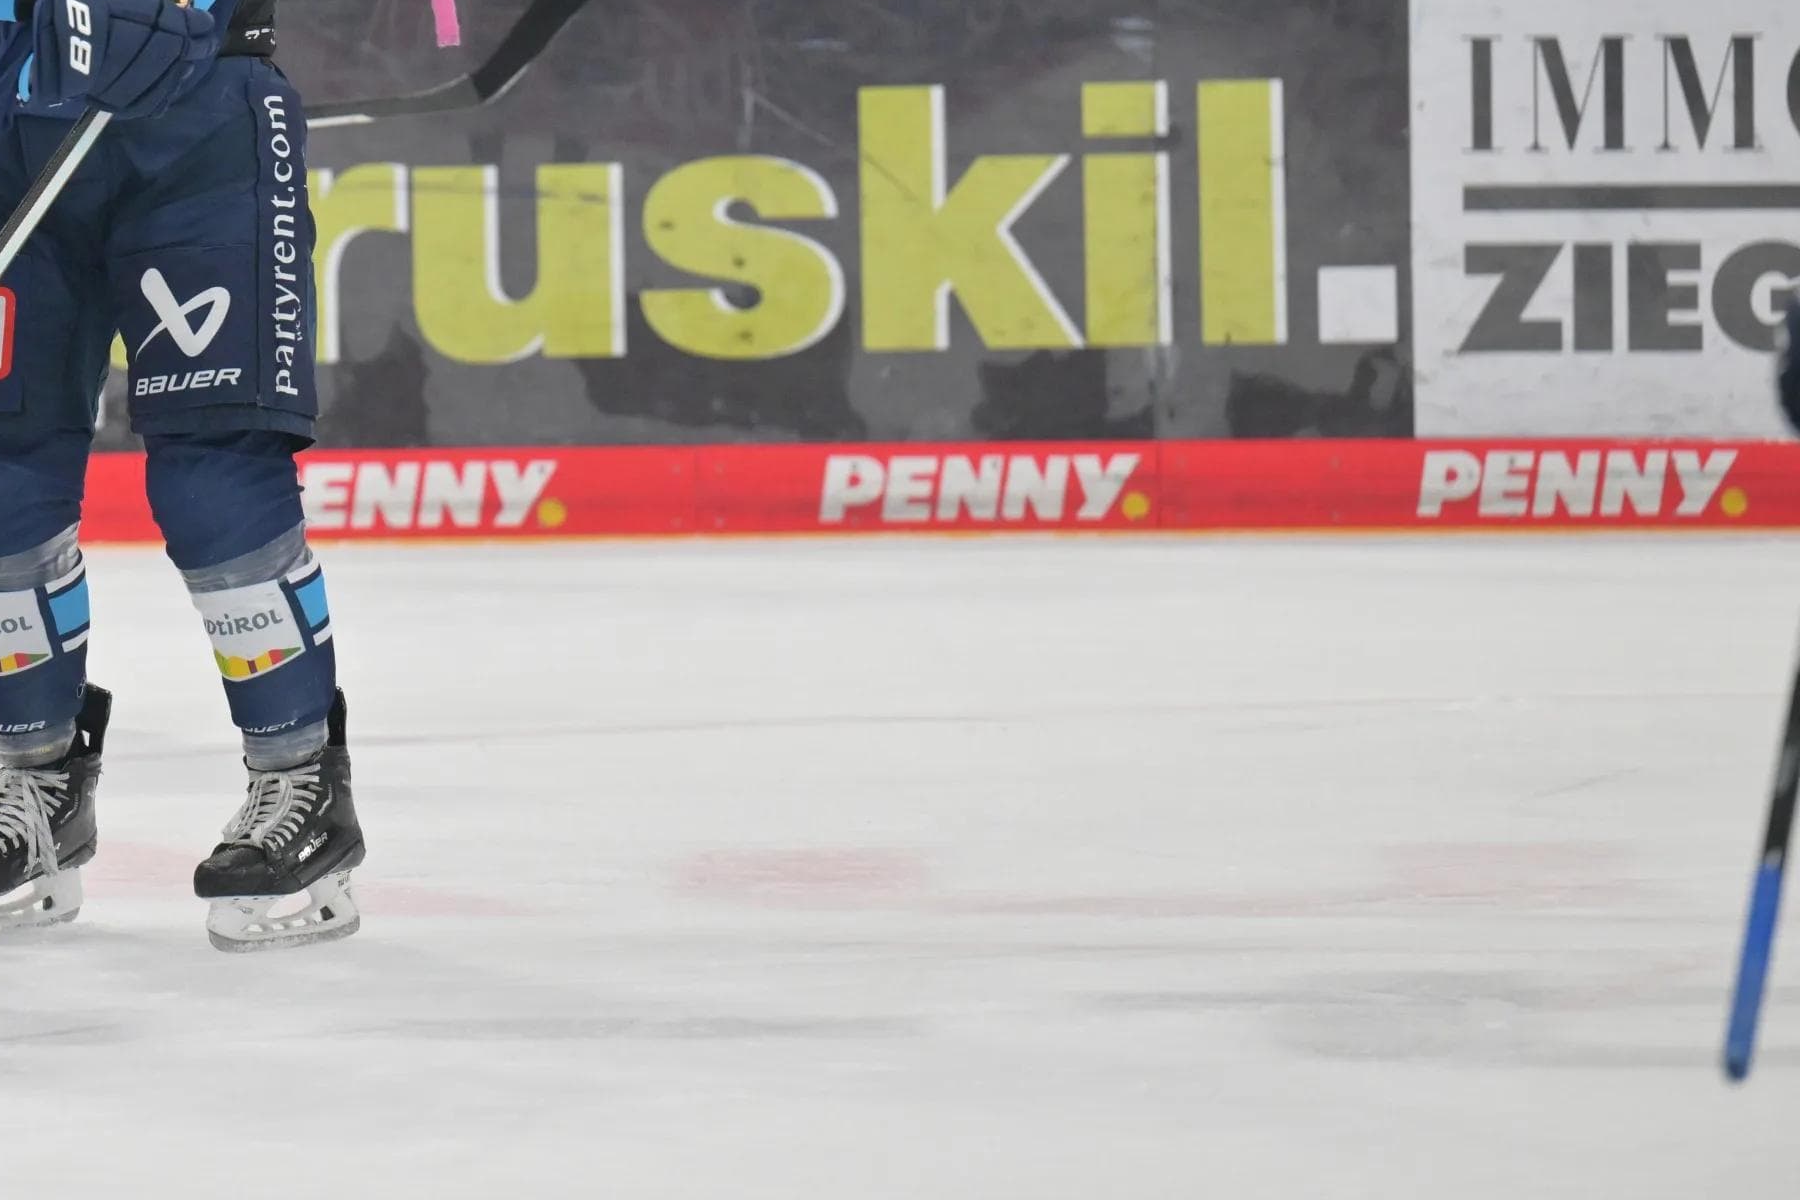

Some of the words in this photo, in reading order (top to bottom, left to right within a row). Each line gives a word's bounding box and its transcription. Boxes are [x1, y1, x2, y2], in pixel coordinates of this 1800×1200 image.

[1462, 33, 1800, 155] IMM
[264, 95, 302, 396] partyrent.com
[135, 367, 242, 397] BAUER
